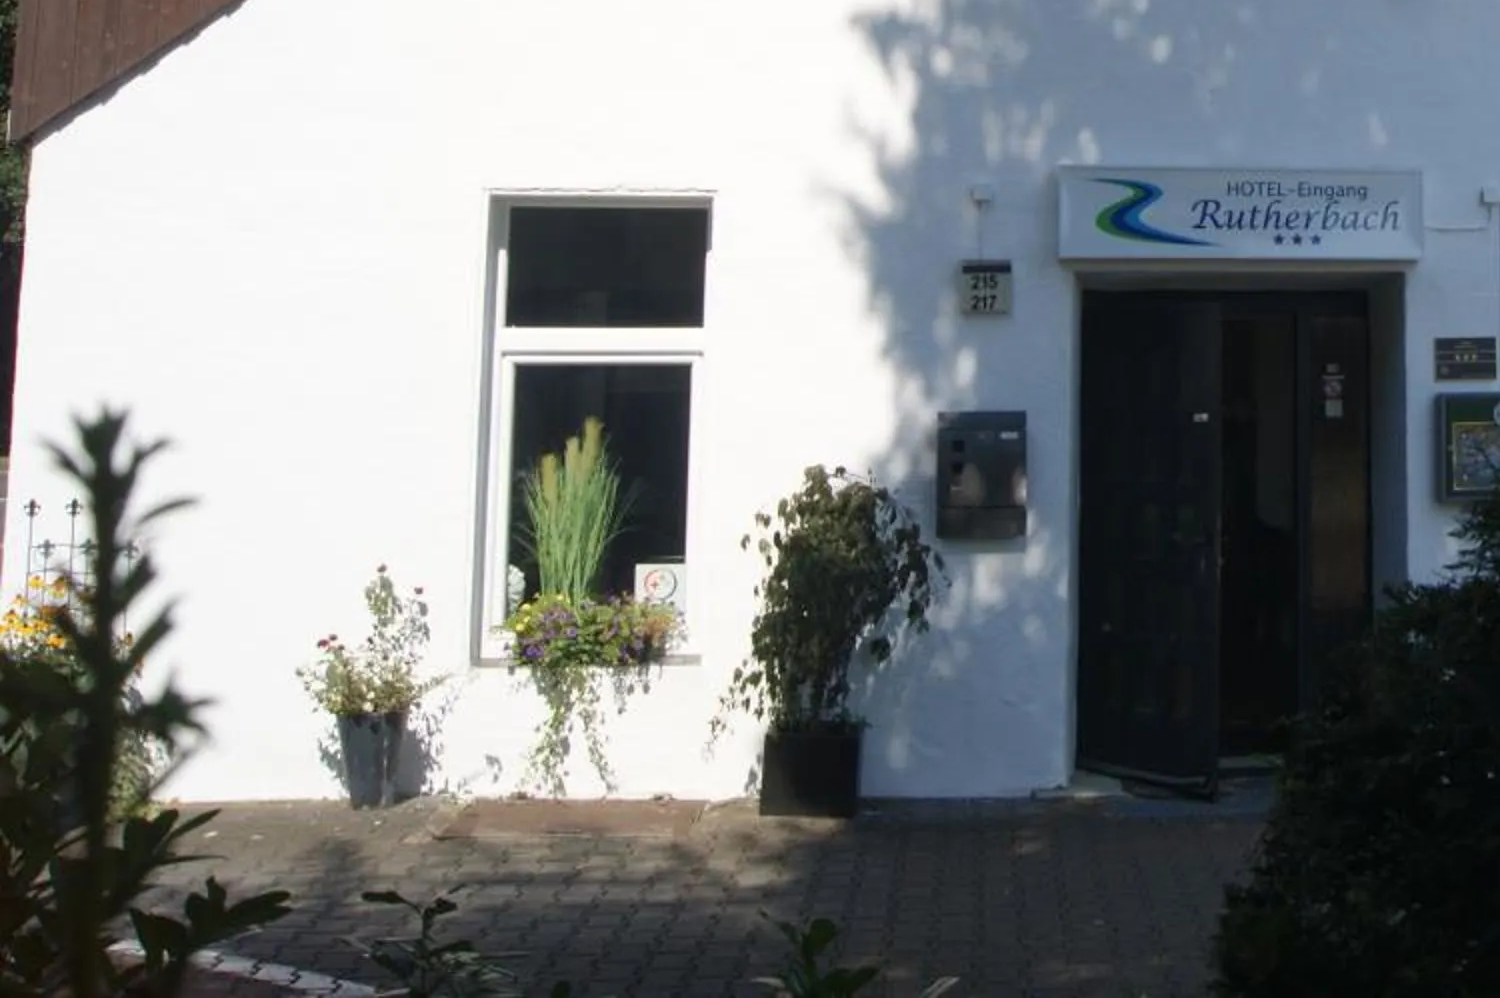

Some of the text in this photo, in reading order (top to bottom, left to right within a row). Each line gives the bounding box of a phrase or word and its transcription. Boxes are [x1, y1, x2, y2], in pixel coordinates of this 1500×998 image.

[1226, 180, 1369, 200] HOTEL-Eingang
[1190, 200, 1401, 232] Rutherbach
[970, 294, 998, 311] 217
